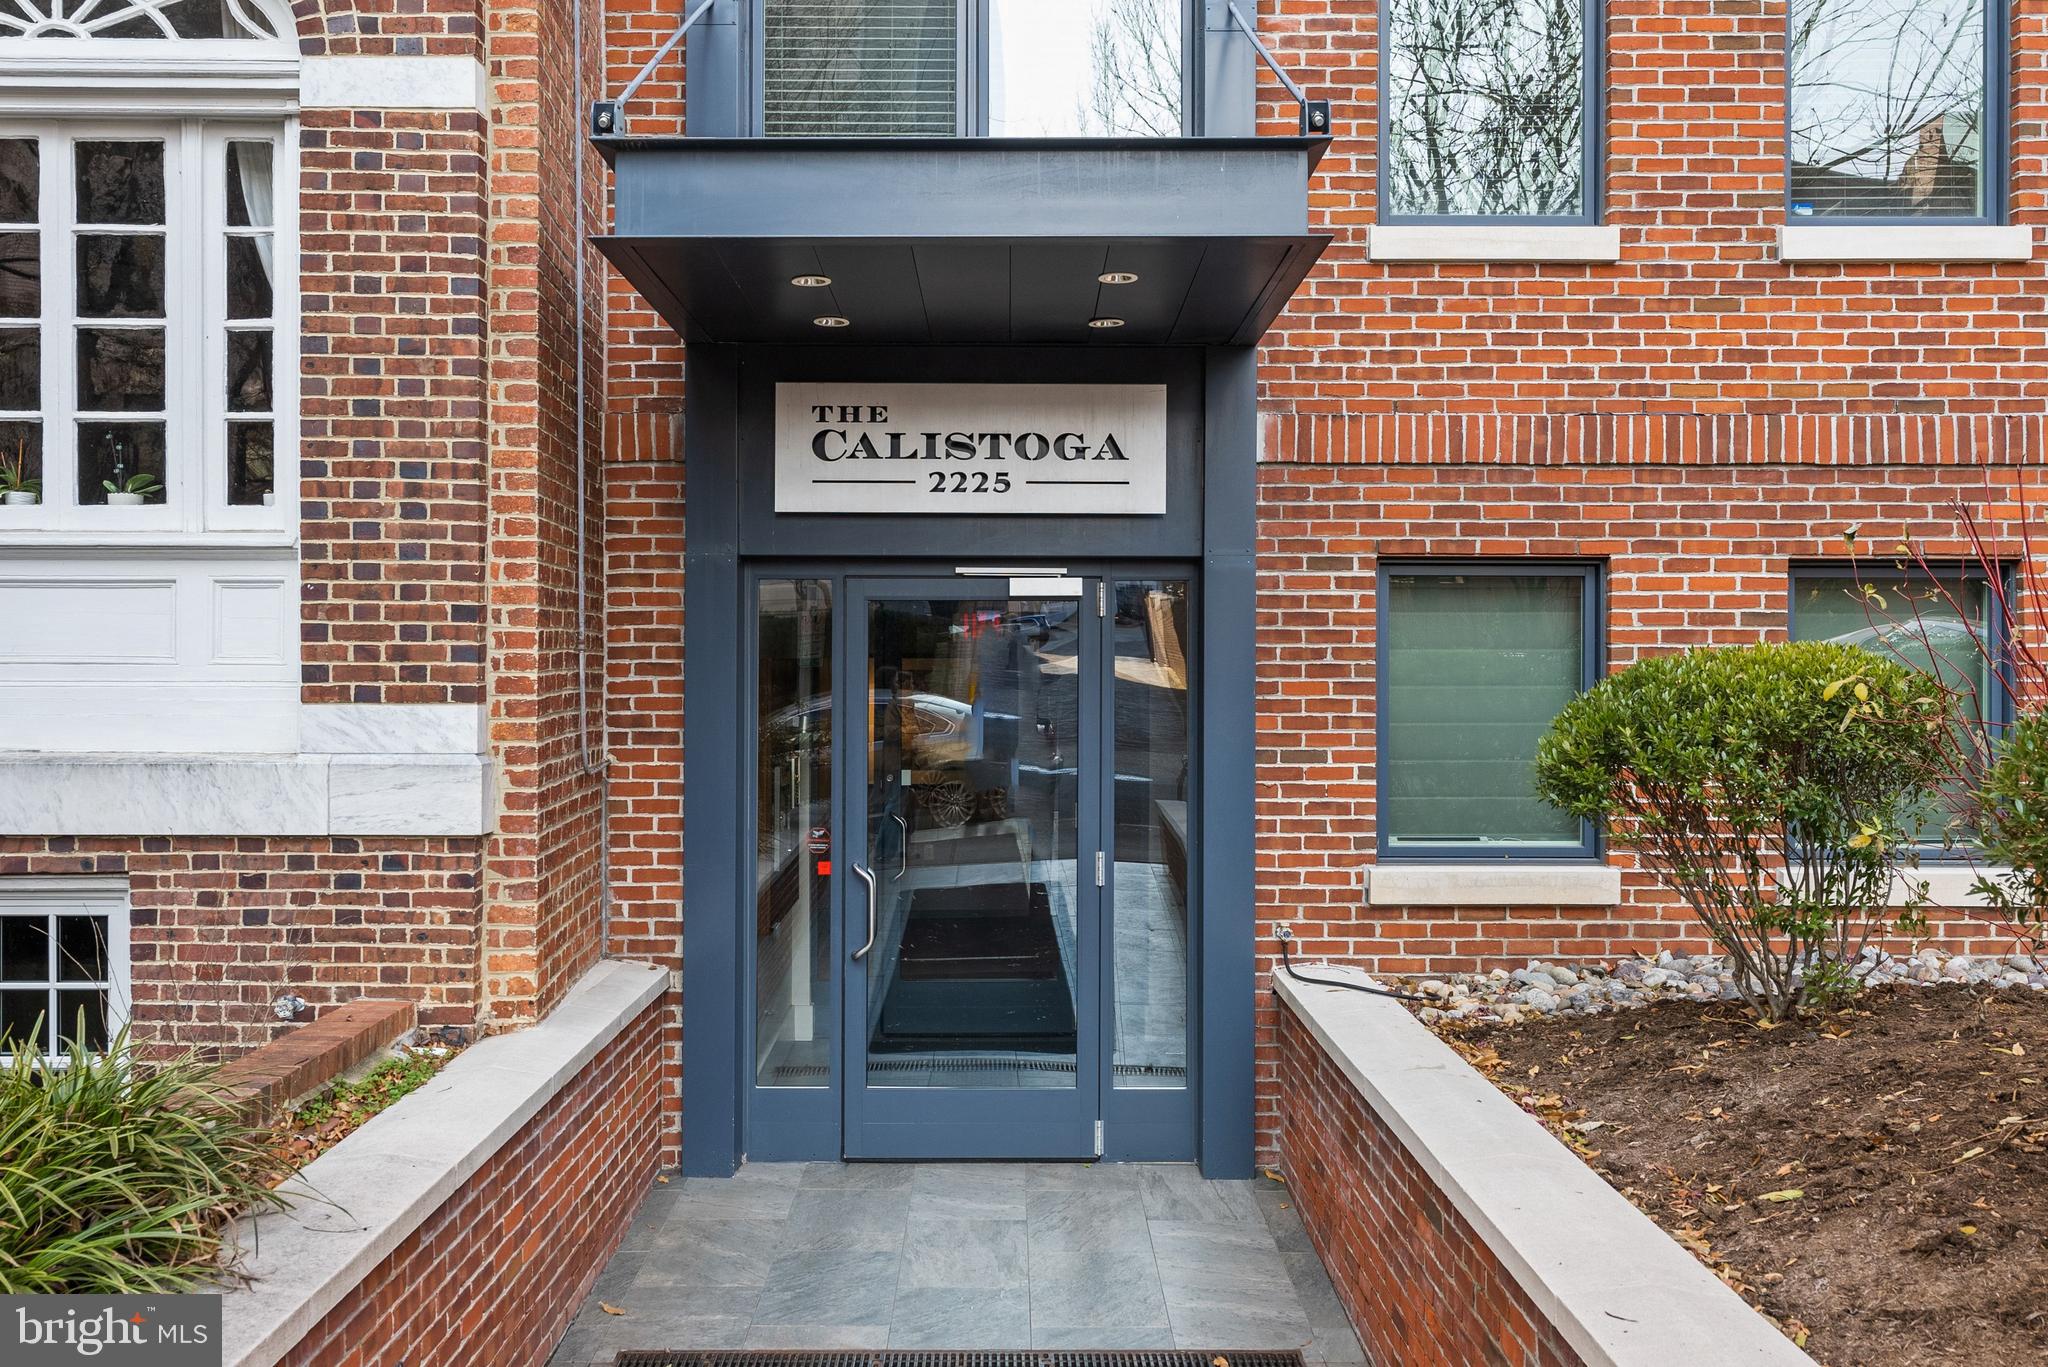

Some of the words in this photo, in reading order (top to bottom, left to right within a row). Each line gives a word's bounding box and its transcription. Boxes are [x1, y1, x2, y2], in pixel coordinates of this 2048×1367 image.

[811, 405, 888, 423] THE
[811, 429, 1130, 462] CALISTOGA
[928, 471, 1011, 494] 2225
